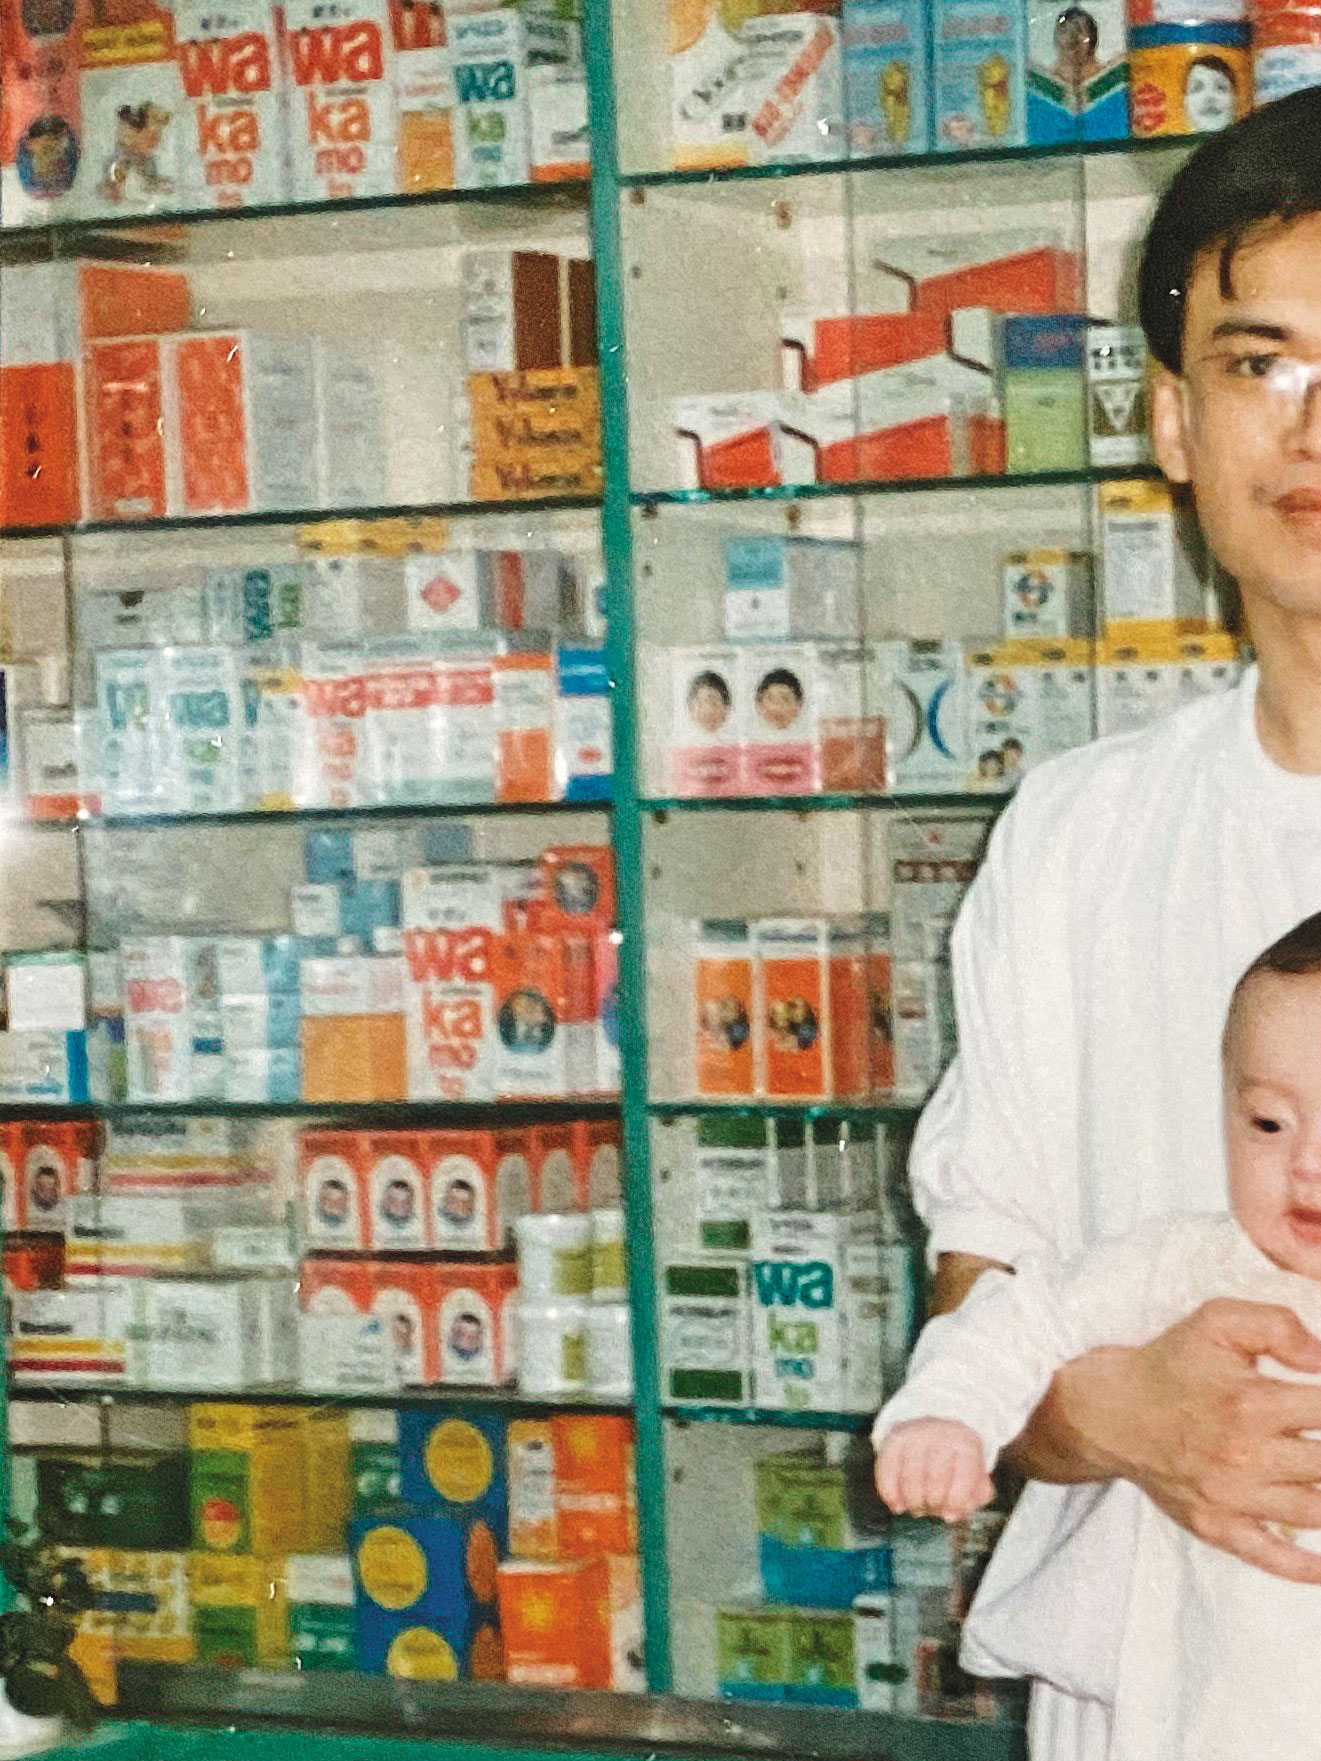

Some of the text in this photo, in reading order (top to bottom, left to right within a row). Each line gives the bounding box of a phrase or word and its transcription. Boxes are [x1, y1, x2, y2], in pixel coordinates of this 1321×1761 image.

[179, 32, 271, 97] wa
[290, 20, 384, 86] wa
[454, 60, 516, 104] wa
[197, 103, 260, 156] ka
[305, 90, 371, 145] ka
[205, 155, 255, 186] mo
[316, 145, 366, 175] mo
[404, 925, 492, 982] wa
[421, 985, 483, 1040] ka
[753, 1260, 834, 1309] wa
[767, 1310, 819, 1355] ka
